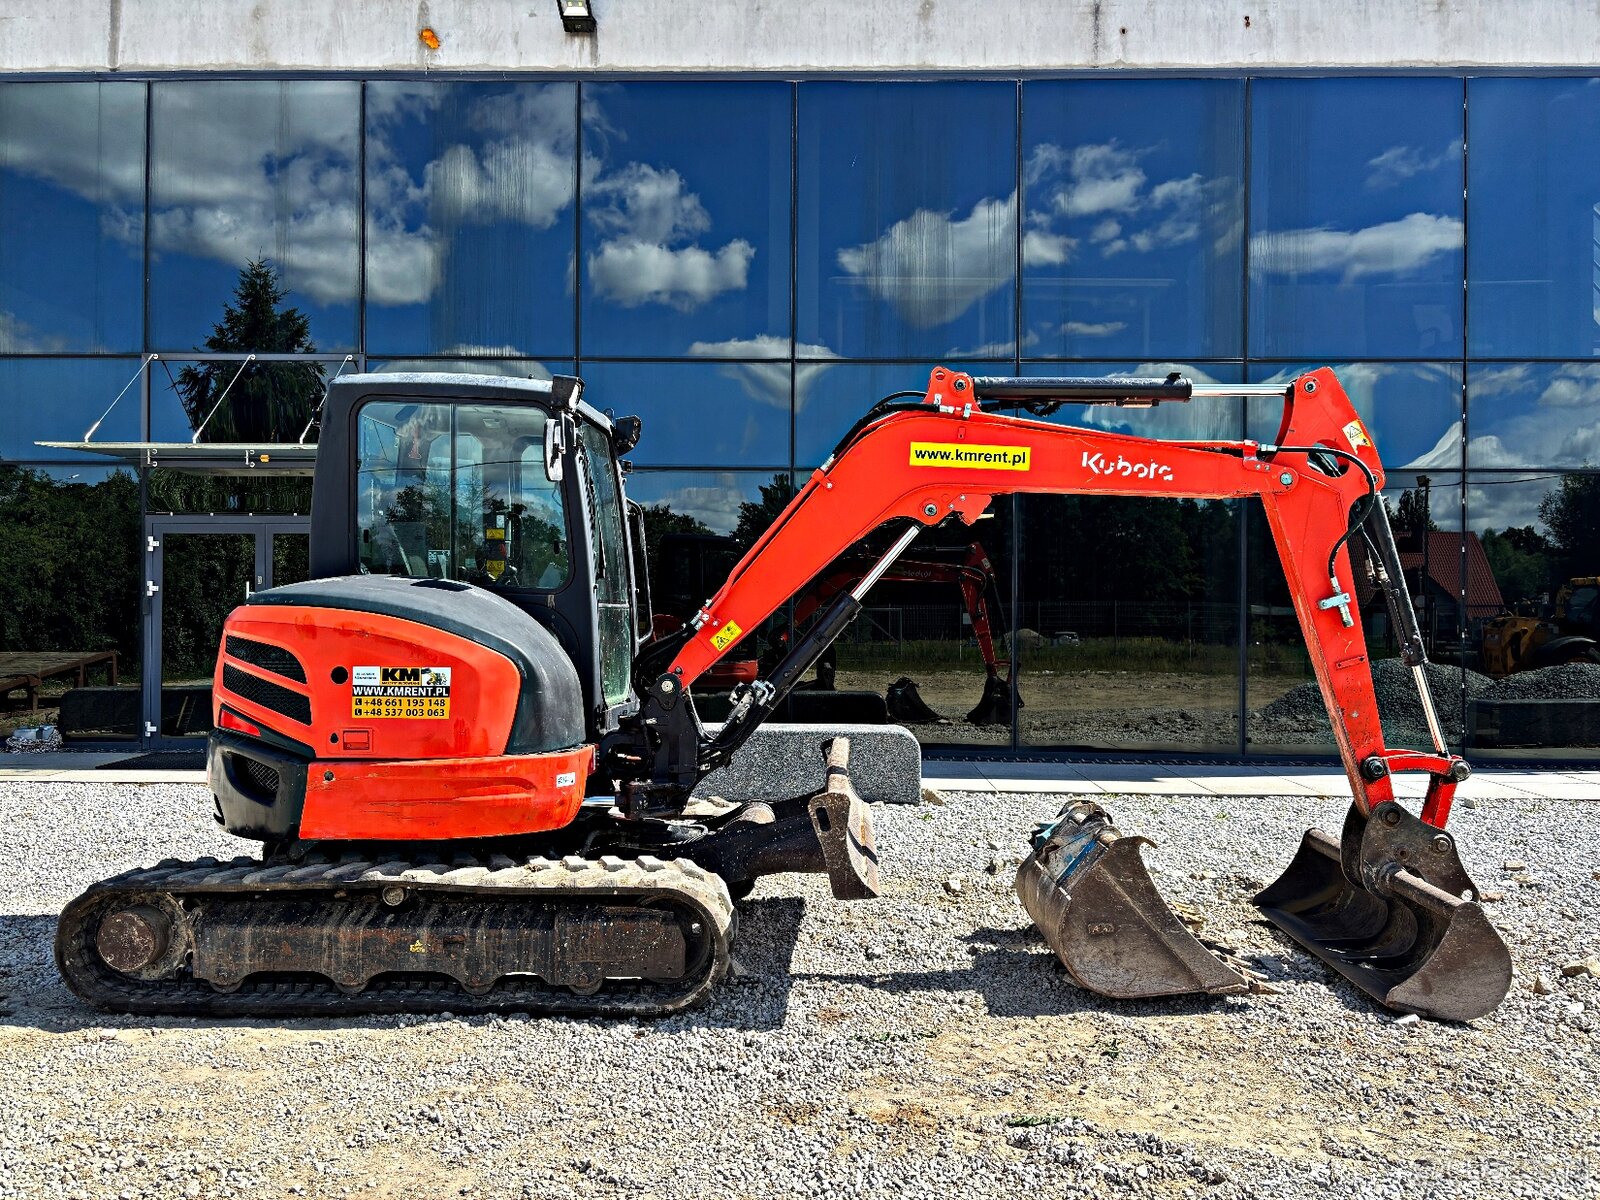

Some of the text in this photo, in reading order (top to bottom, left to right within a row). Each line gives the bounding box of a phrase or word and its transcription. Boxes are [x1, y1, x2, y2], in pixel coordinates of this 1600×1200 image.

[915, 449, 1026, 466] www.kmrent.pl
[382, 668, 419, 681] KM
[353, 687, 448, 696] WWW.KMRENT.PL
